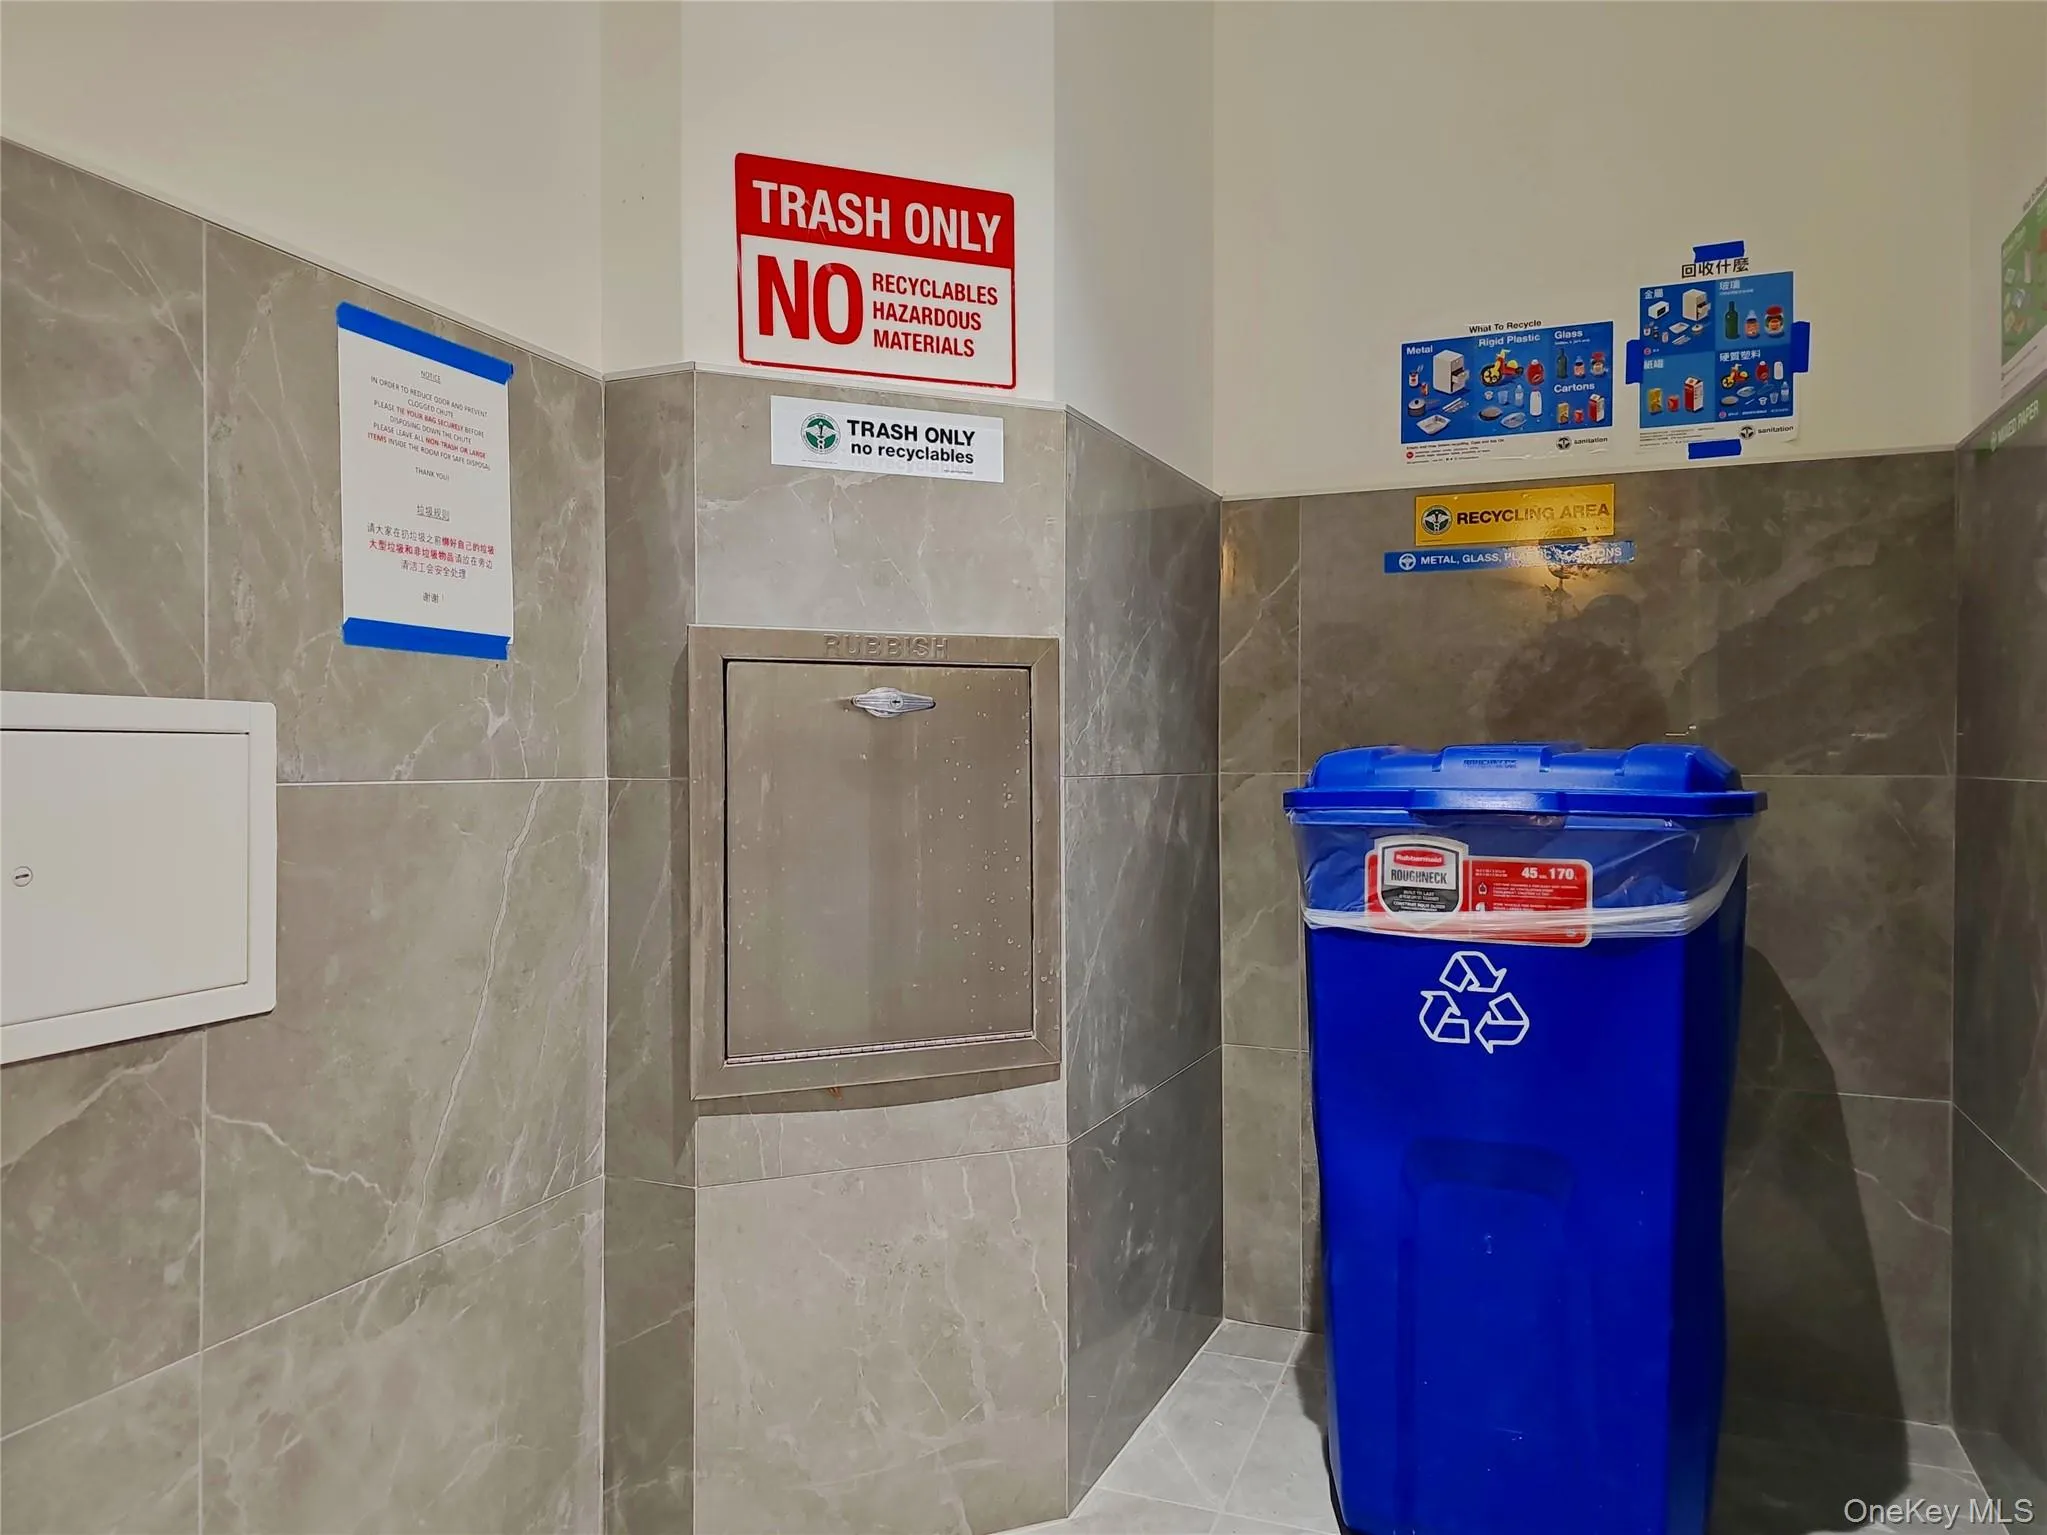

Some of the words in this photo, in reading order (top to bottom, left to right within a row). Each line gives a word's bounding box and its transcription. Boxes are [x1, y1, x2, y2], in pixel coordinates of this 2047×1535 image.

[752, 180, 890, 240] TRASH
[905, 202, 1002, 254] ONLY
[1682, 258, 1750, 278] 回收什麼
[757, 254, 864, 345] NO
[872, 272, 998, 306] RECYCLABLES
[872, 300, 982, 331] HAZARDOUS
[1469, 324, 1492, 334] What
[1506, 320, 1542, 332] Recycle
[1554, 330, 1584, 340] Glass
[873, 329, 975, 358] MATERIALS
[1406, 344, 1434, 356] Metal
[1478, 336, 1504, 348] Rigid
[1506, 332, 1541, 344] Plastic
[370, 376, 378, 384] IN
[379, 379, 400, 391] ORDER
[400, 385, 409, 394] TO
[410, 388, 432, 401] REDUCE
[434, 396, 450, 406] ODOR
[451, 400, 464, 410] AND
[464, 404, 488, 418] PREVENT
[1554, 383, 1596, 393] Cartons
[374, 400, 395, 412] PLEASE
[396, 406, 404, 415] TIE
[406, 408, 423, 420] YOUR
[424, 414, 437, 424] BAG
[438, 418, 464, 432] SECURELY
[464, 426, 484, 438] BEFORE
[408, 398, 435, 412] CLOGGED
[436, 407, 454, 418] CHUTE
[2018, 400, 2038, 431] PAPER
[390, 416, 420, 430] DISPOSING
[422, 424, 442, 436] DOWN
[442, 430, 452, 440] THE
[454, 434, 472, 445] CHUTE
[847, 419, 918, 442] TRASH
[925, 427, 976, 446] ONLY
[1758, 425, 1794, 434] sanitation
[368, 432, 387, 444] ITEMS
[388, 438, 407, 449] INSIDE
[408, 442, 419, 452] THE
[420, 446, 440, 458] ROOM
[440, 452, 452, 460] FOR
[452, 454, 466, 464] SAFE
[373, 422, 394, 434] PLEASE
[396, 428, 412, 440] LEAVE
[414, 433, 424, 443] ALL
[441, 441, 458, 452] TRASH
[460, 446, 468, 455] OR
[469, 448, 486, 460] LARGE
[1574, 436, 1608, 446] sanitation
[851, 442, 872, 455] no
[878, 445, 974, 464] recyclables
[415, 466, 436, 478] THANK
[1456, 508, 1555, 525] RECYCLING
[1560, 503, 1610, 520] AREA
[1420, 554, 1460, 566] METAL,
[1462, 552, 1502, 564] GLASS,
[824, 634, 948, 659] RUBBISH
[1396, 854, 1442, 863] Rubbermaid
[1391, 869, 1448, 884] ROUGHNECK
[1522, 867, 1538, 878] 45
[1550, 868, 1575, 880] 170
